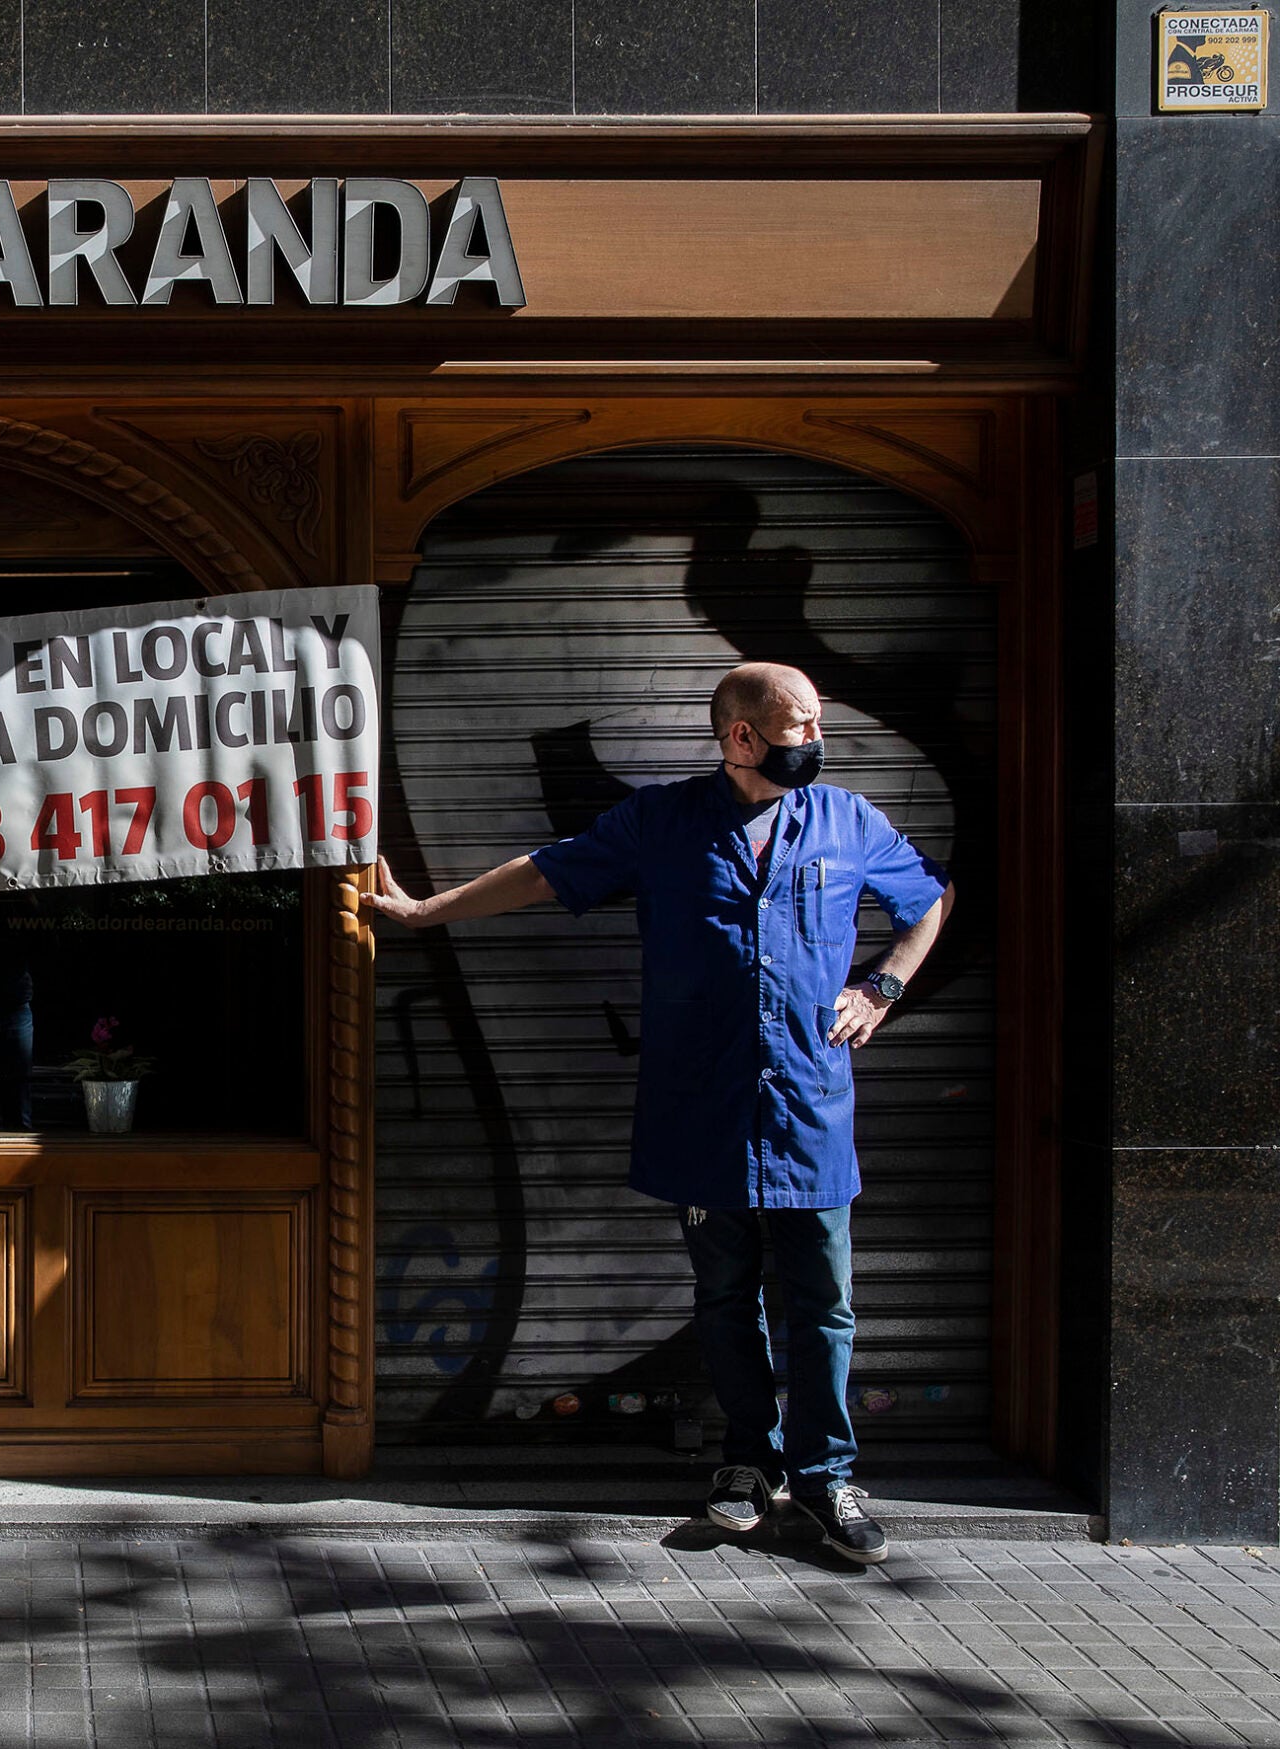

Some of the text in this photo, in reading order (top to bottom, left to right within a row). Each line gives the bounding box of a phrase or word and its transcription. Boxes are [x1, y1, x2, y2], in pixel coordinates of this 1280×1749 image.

[1168, 18, 1258, 29] CONECTADA
[1166, 85, 1258, 97] PROSEGUR
[14, 635, 94, 694] EN
[113, 617, 298, 684] LOCAL
[310, 614, 349, 669] Y
[34, 684, 366, 762] DOMICILIO
[31, 786, 156, 860] 417
[183, 778, 270, 850] 01
[293, 771, 373, 841] 15
